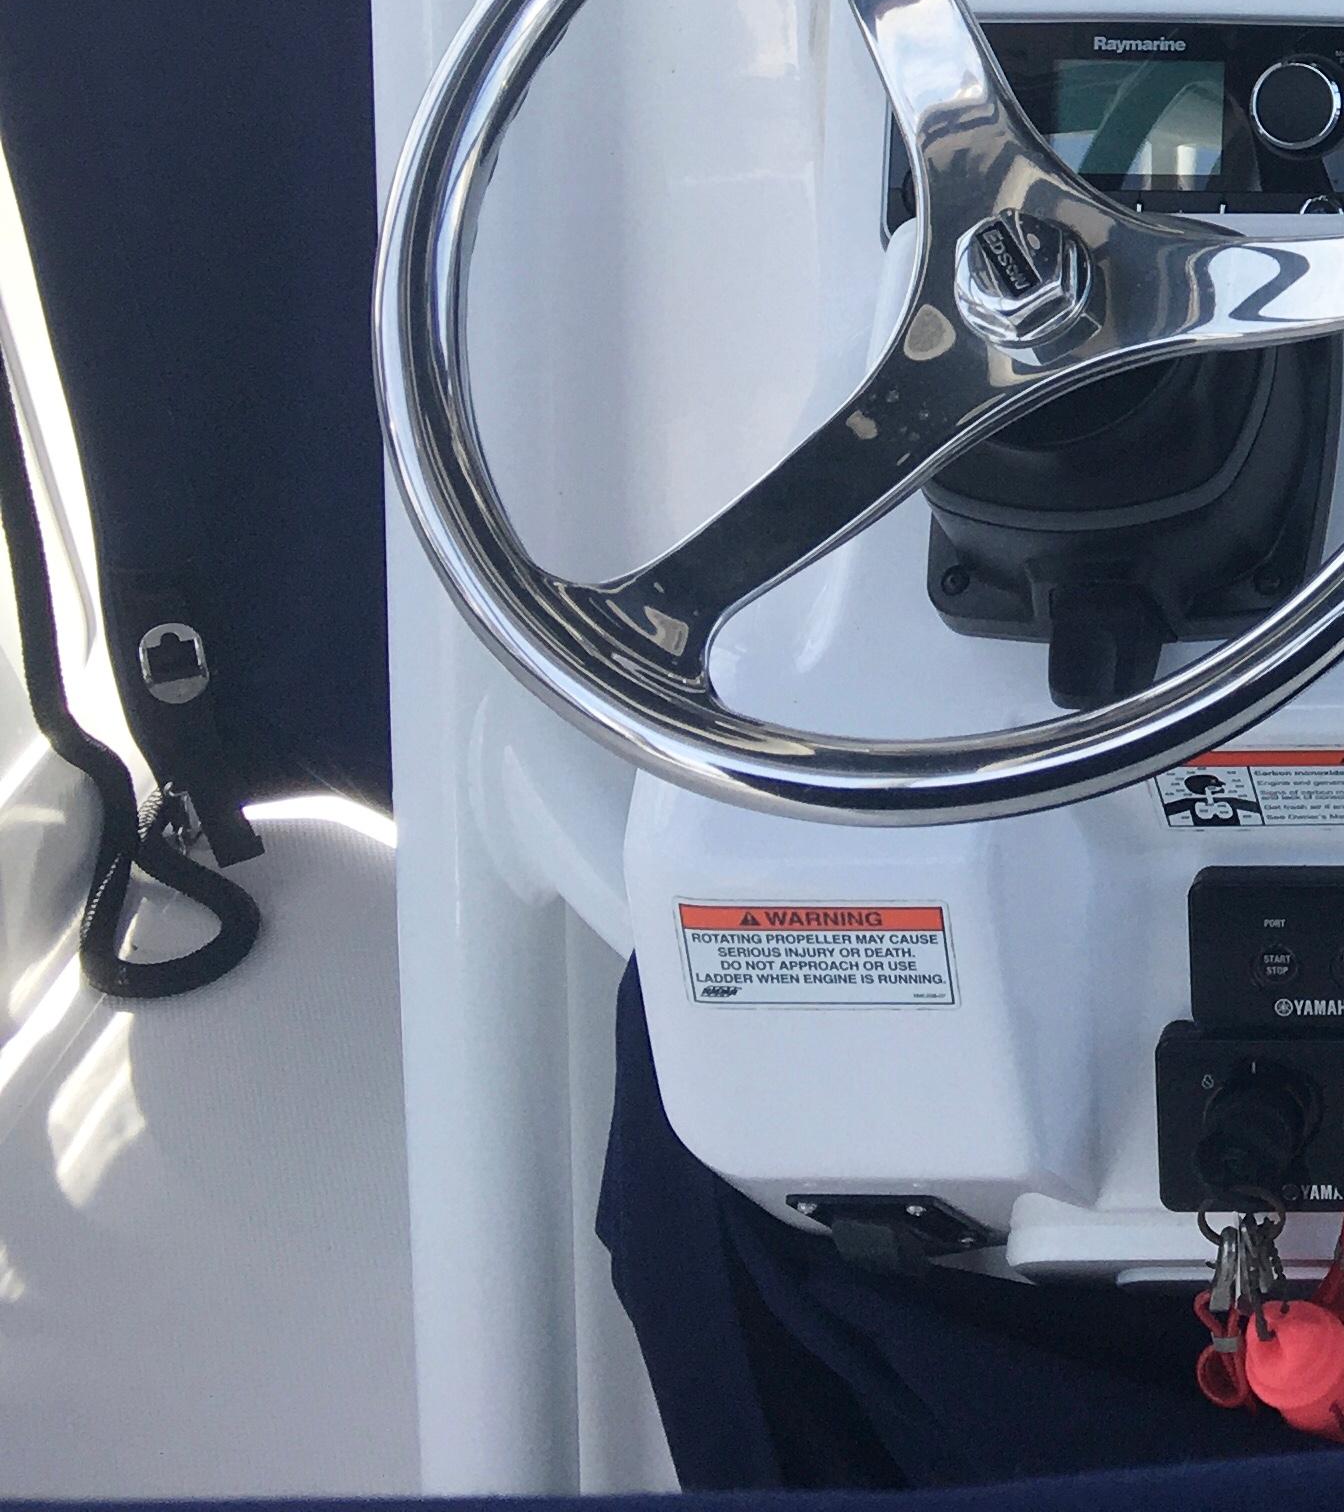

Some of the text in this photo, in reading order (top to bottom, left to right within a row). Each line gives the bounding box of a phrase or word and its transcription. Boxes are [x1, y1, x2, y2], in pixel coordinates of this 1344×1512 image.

[1093, 36, 1186, 53] Raymarine
[765, 911, 882, 926] WARNING
[1263, 919, 1286, 928] PORT
[692, 933, 938, 945] ROTATING PROPELLER MAY CAUSE
[717, 947, 916, 958] SERIOUS INJURY OR DEATH.
[1263, 954, 1291, 964] START
[720, 960, 917, 971] DO NOT APPROACH OR USE
[1266, 966, 1289, 975] STOP
[696, 973, 947, 985] LADDER WHEN ENGINE IS RUNNING.
